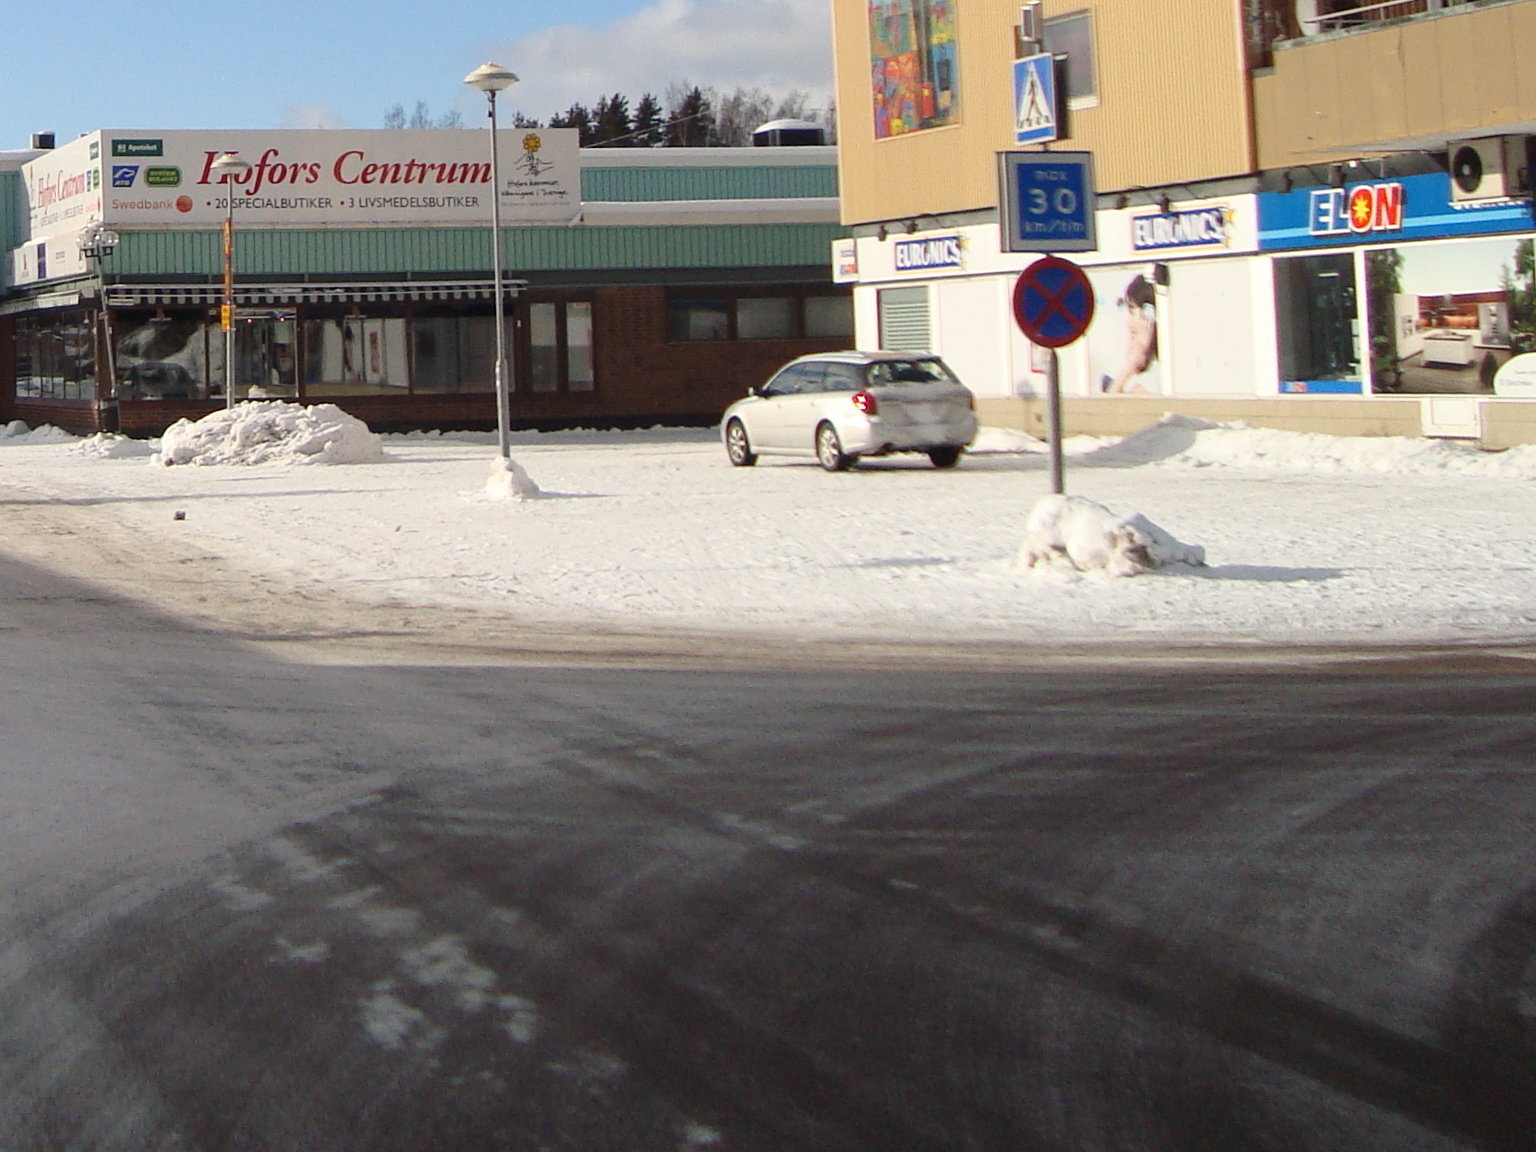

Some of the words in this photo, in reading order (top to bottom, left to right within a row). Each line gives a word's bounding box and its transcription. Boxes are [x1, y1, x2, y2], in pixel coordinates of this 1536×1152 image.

[333, 150, 492, 185] Centrum
[112, 199, 174, 209] Swedbank
[215, 199, 228, 208] 20
[231, 198, 333, 209] SPECIALBUTIKER
[348, 198, 355, 208] 3
[358, 197, 480, 208] LIVSMEDELSBUTIKER
[1027, 188, 1077, 215] 30
[1309, 183, 1402, 235] ELON
[895, 239, 961, 268] EURONICS
